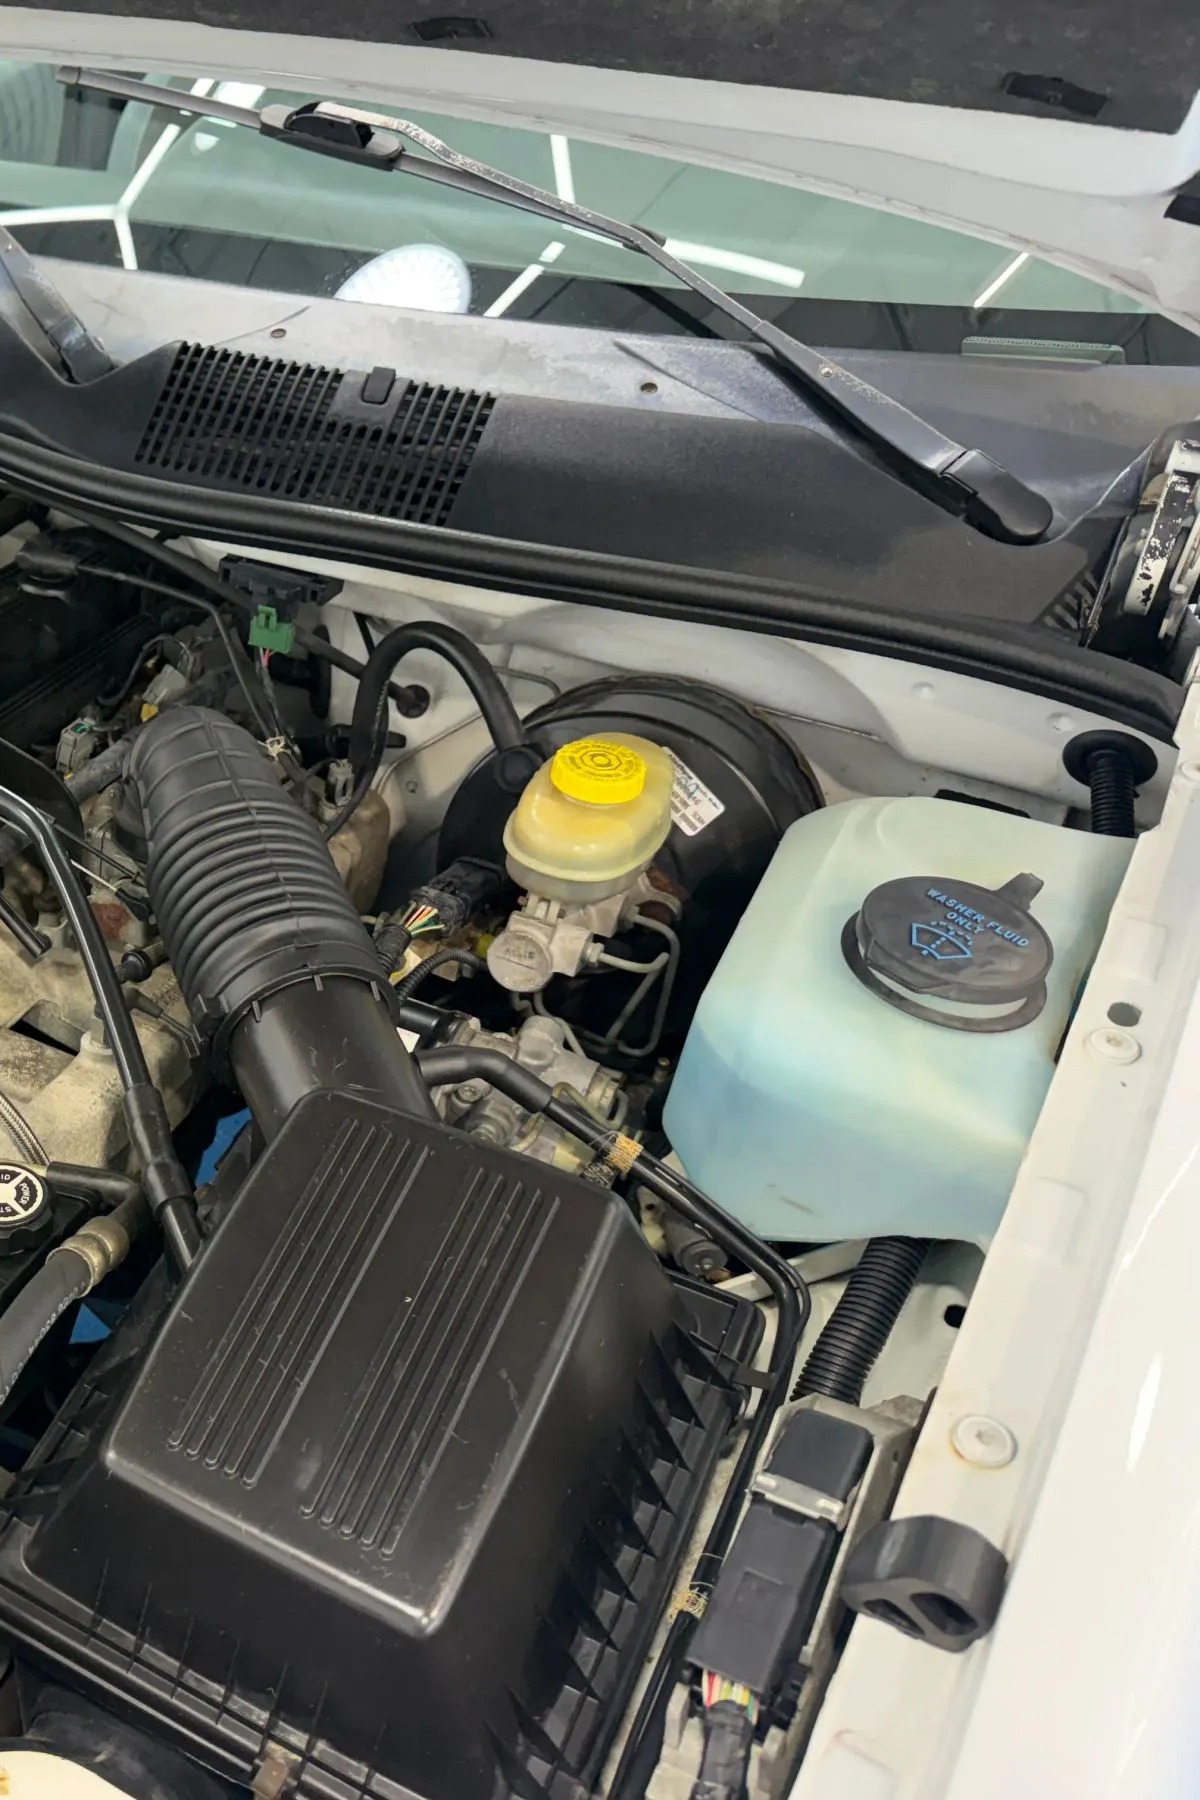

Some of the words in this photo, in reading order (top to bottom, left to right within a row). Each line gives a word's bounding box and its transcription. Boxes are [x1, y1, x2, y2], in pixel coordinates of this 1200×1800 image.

[926, 888, 985, 922] WASHER
[986, 921, 1031, 947] FLUID
[945, 911, 986, 934] ONLY
[19, 1182, 31, 1205] POWER
